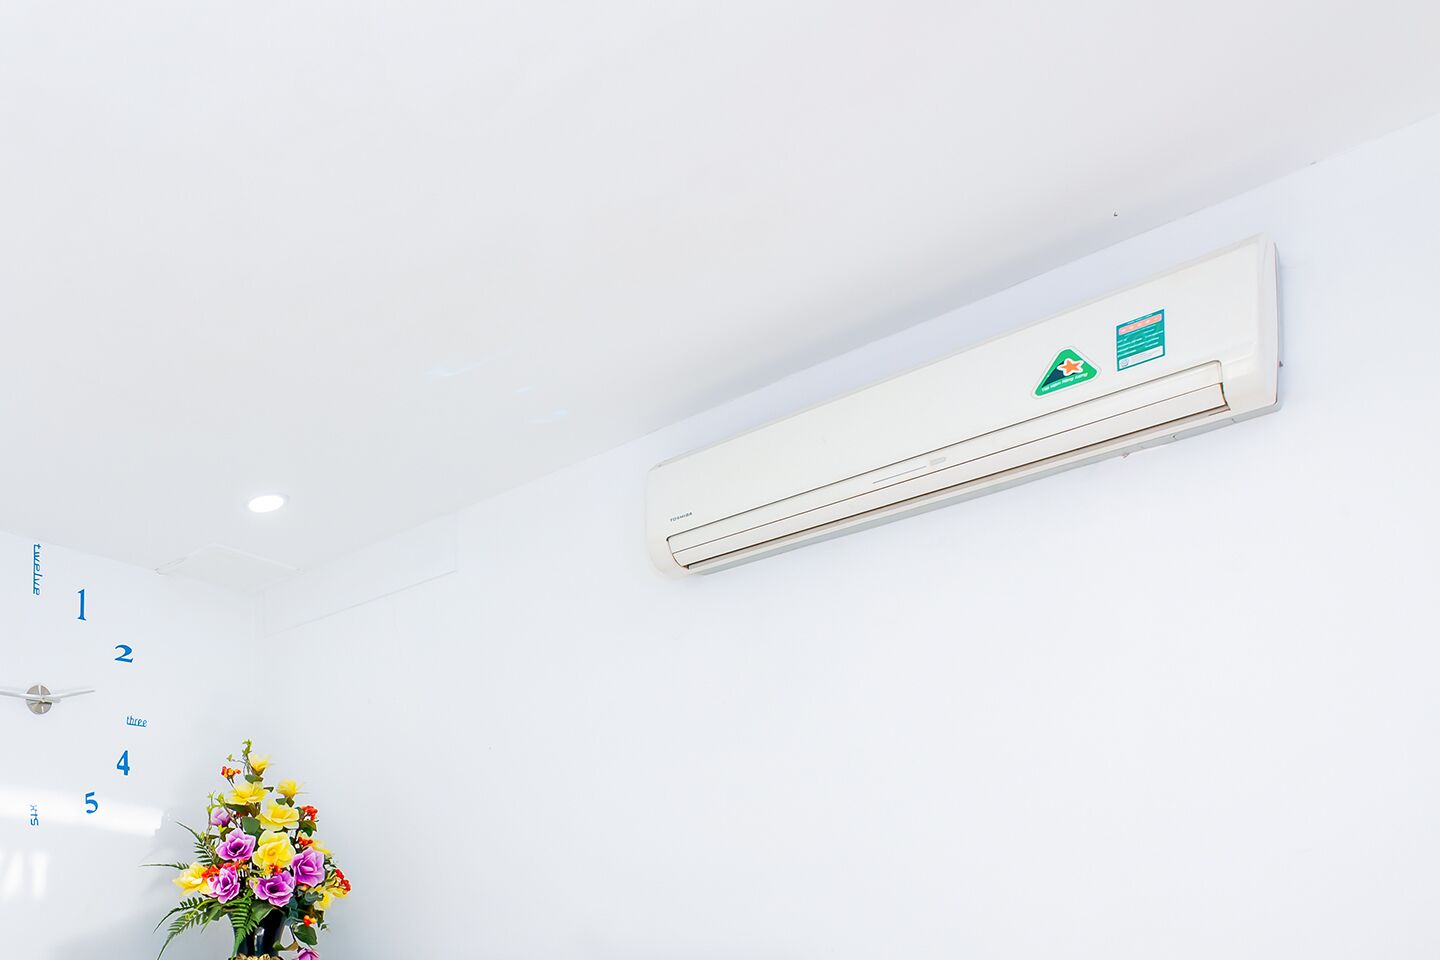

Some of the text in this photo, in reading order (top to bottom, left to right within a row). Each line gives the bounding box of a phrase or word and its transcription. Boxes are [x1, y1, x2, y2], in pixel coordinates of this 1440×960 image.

[33, 543, 43, 596] twelve
[77, 588, 87, 621] 1
[114, 644, 134, 664] 2
[126, 715, 148, 728] three
[116, 750, 131, 776] 4
[84, 791, 99, 814] 5
